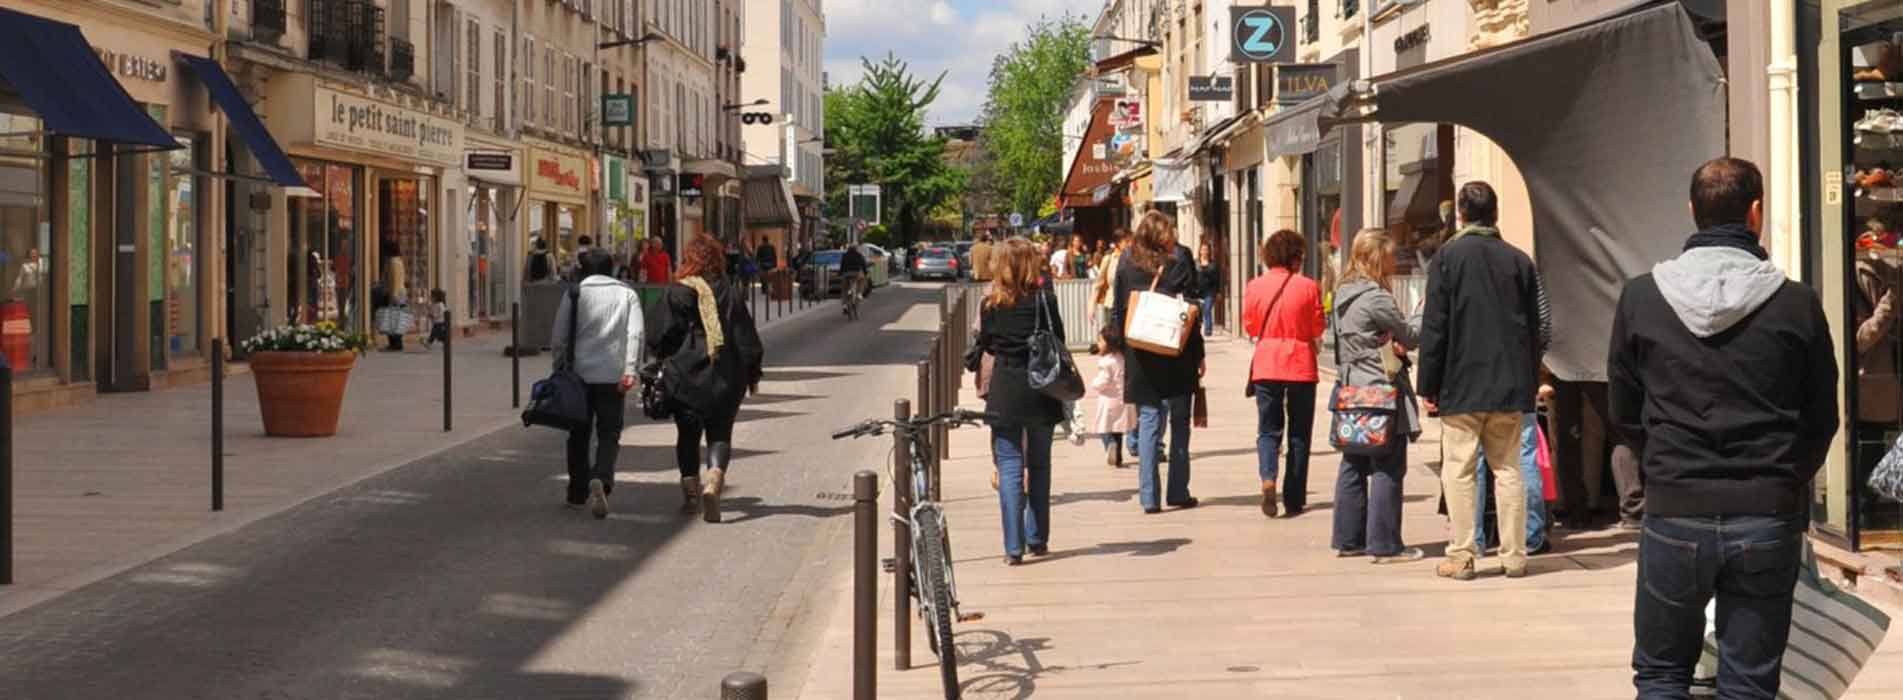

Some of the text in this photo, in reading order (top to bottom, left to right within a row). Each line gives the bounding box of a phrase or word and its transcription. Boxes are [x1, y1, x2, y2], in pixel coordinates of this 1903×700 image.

[1243, 16, 1275, 52] Z
[332, 94, 344, 124] le
[349, 103, 383, 133] petit
[385, 111, 417, 139] saint
[419, 118, 453, 147] pierre
